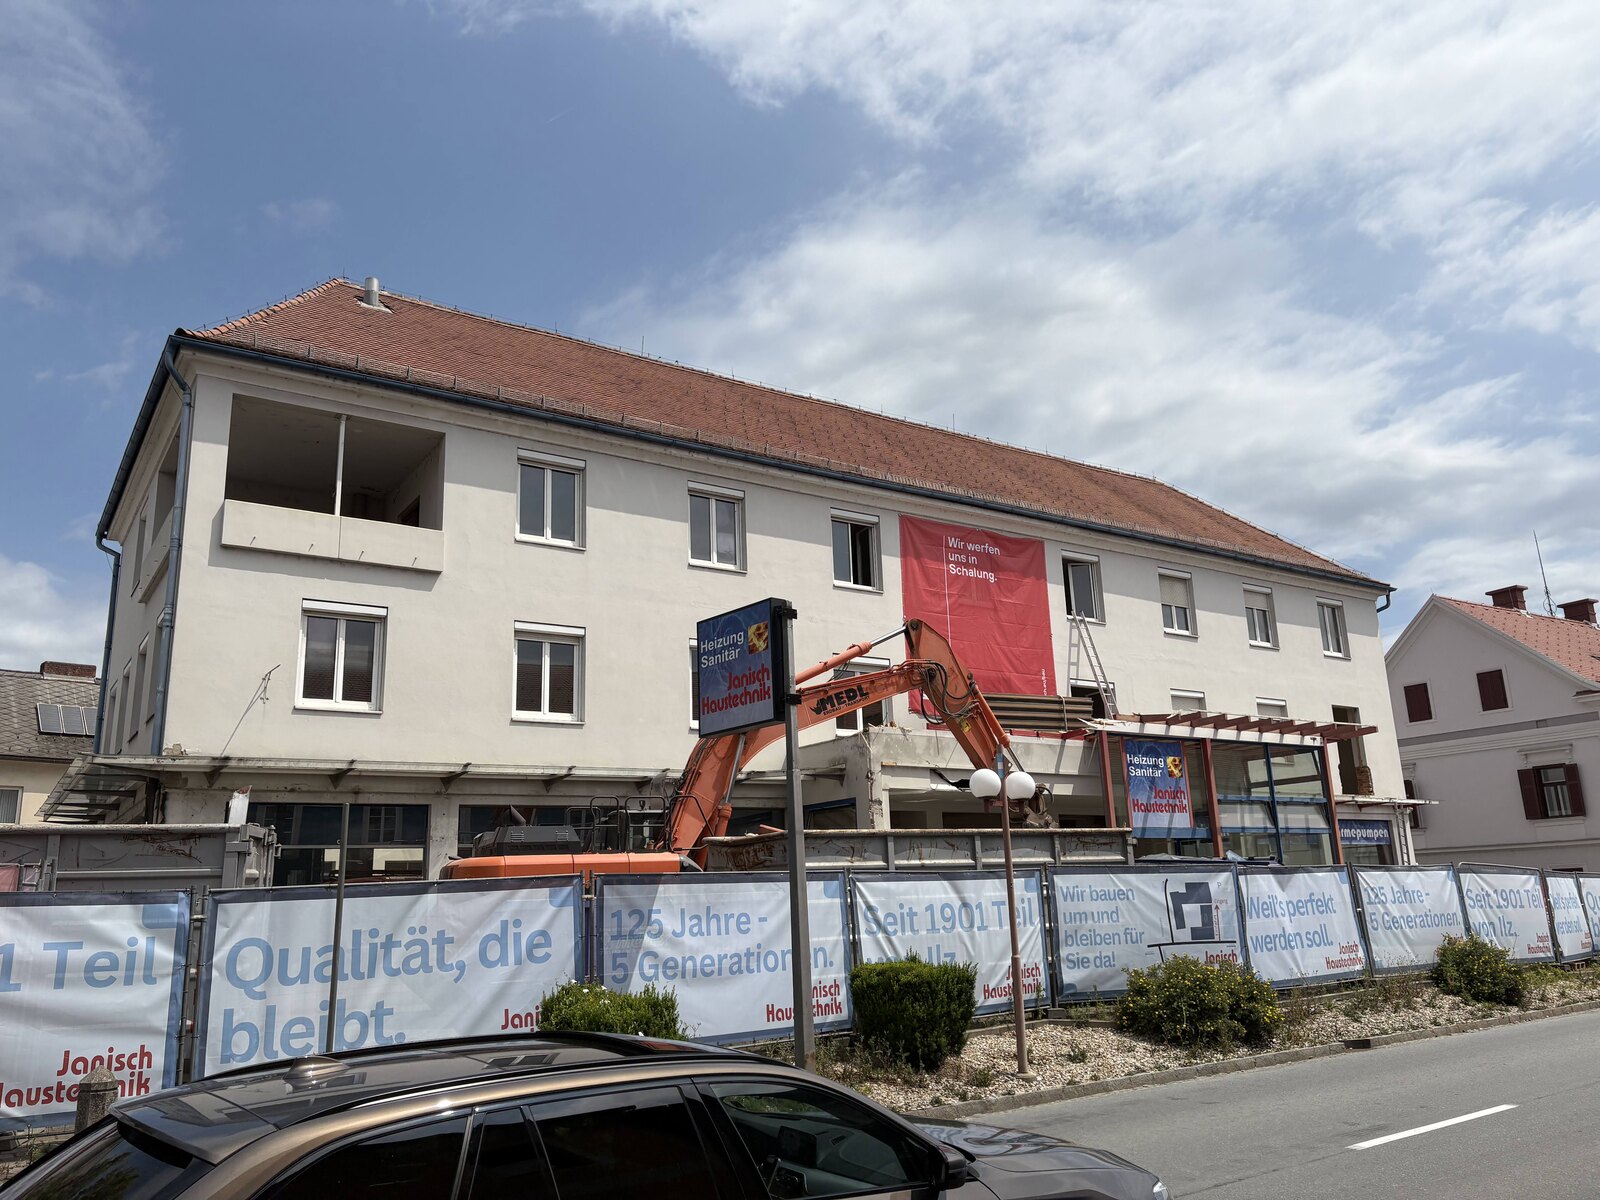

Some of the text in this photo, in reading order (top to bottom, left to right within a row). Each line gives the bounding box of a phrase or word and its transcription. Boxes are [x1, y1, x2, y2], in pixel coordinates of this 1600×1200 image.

[948, 536, 1001, 556] Wir werfen
[948, 552, 978, 565] uns in
[949, 563, 998, 583] Schalung.
[700, 631, 744, 654] Heizung
[701, 646, 741, 668] Sanitär
[727, 663, 771, 691] Janisch
[701, 683, 772, 716] Haustechnik
[819, 684, 870, 712] MEDL
[1126, 753, 1165, 768] Heizung
[1128, 766, 1162, 777] Sanitär
[1153, 785, 1187, 800] Janisch
[1132, 798, 1188, 814] Haustechnik
[1060, 884, 1136, 902] Wir bauen
[1363, 885, 1388, 906] 125
[1390, 884, 1425, 905] Jahre
[1465, 888, 1494, 910] Seit
[1493, 888, 1525, 910] 1901
[1523, 888, 1544, 909] Teil
[1063, 906, 1120, 925] um und
[1286, 891, 1336, 923] perfekt
[610, 908, 664, 941] 125
[671, 905, 751, 938] Jahre
[863, 902, 919, 937] Seit
[924, 900, 988, 935] 1901
[1369, 908, 1461, 932] 5 Generationen.
[1472, 920, 1497, 937] von
[1064, 928, 1121, 948] bleiben
[1123, 927, 1145, 946] für
[1249, 923, 1334, 954] werden soll.
[43, 936, 158, 990] Teil
[225, 918, 552, 1001] Qualität, die
[611, 943, 834, 985] 5 Generationn.
[1066, 951, 1116, 970] Sie da!
[501, 1004, 541, 1031] Jani
[219, 998, 406, 1065] bleibt.
[57, 1044, 153, 1077] Janisch
